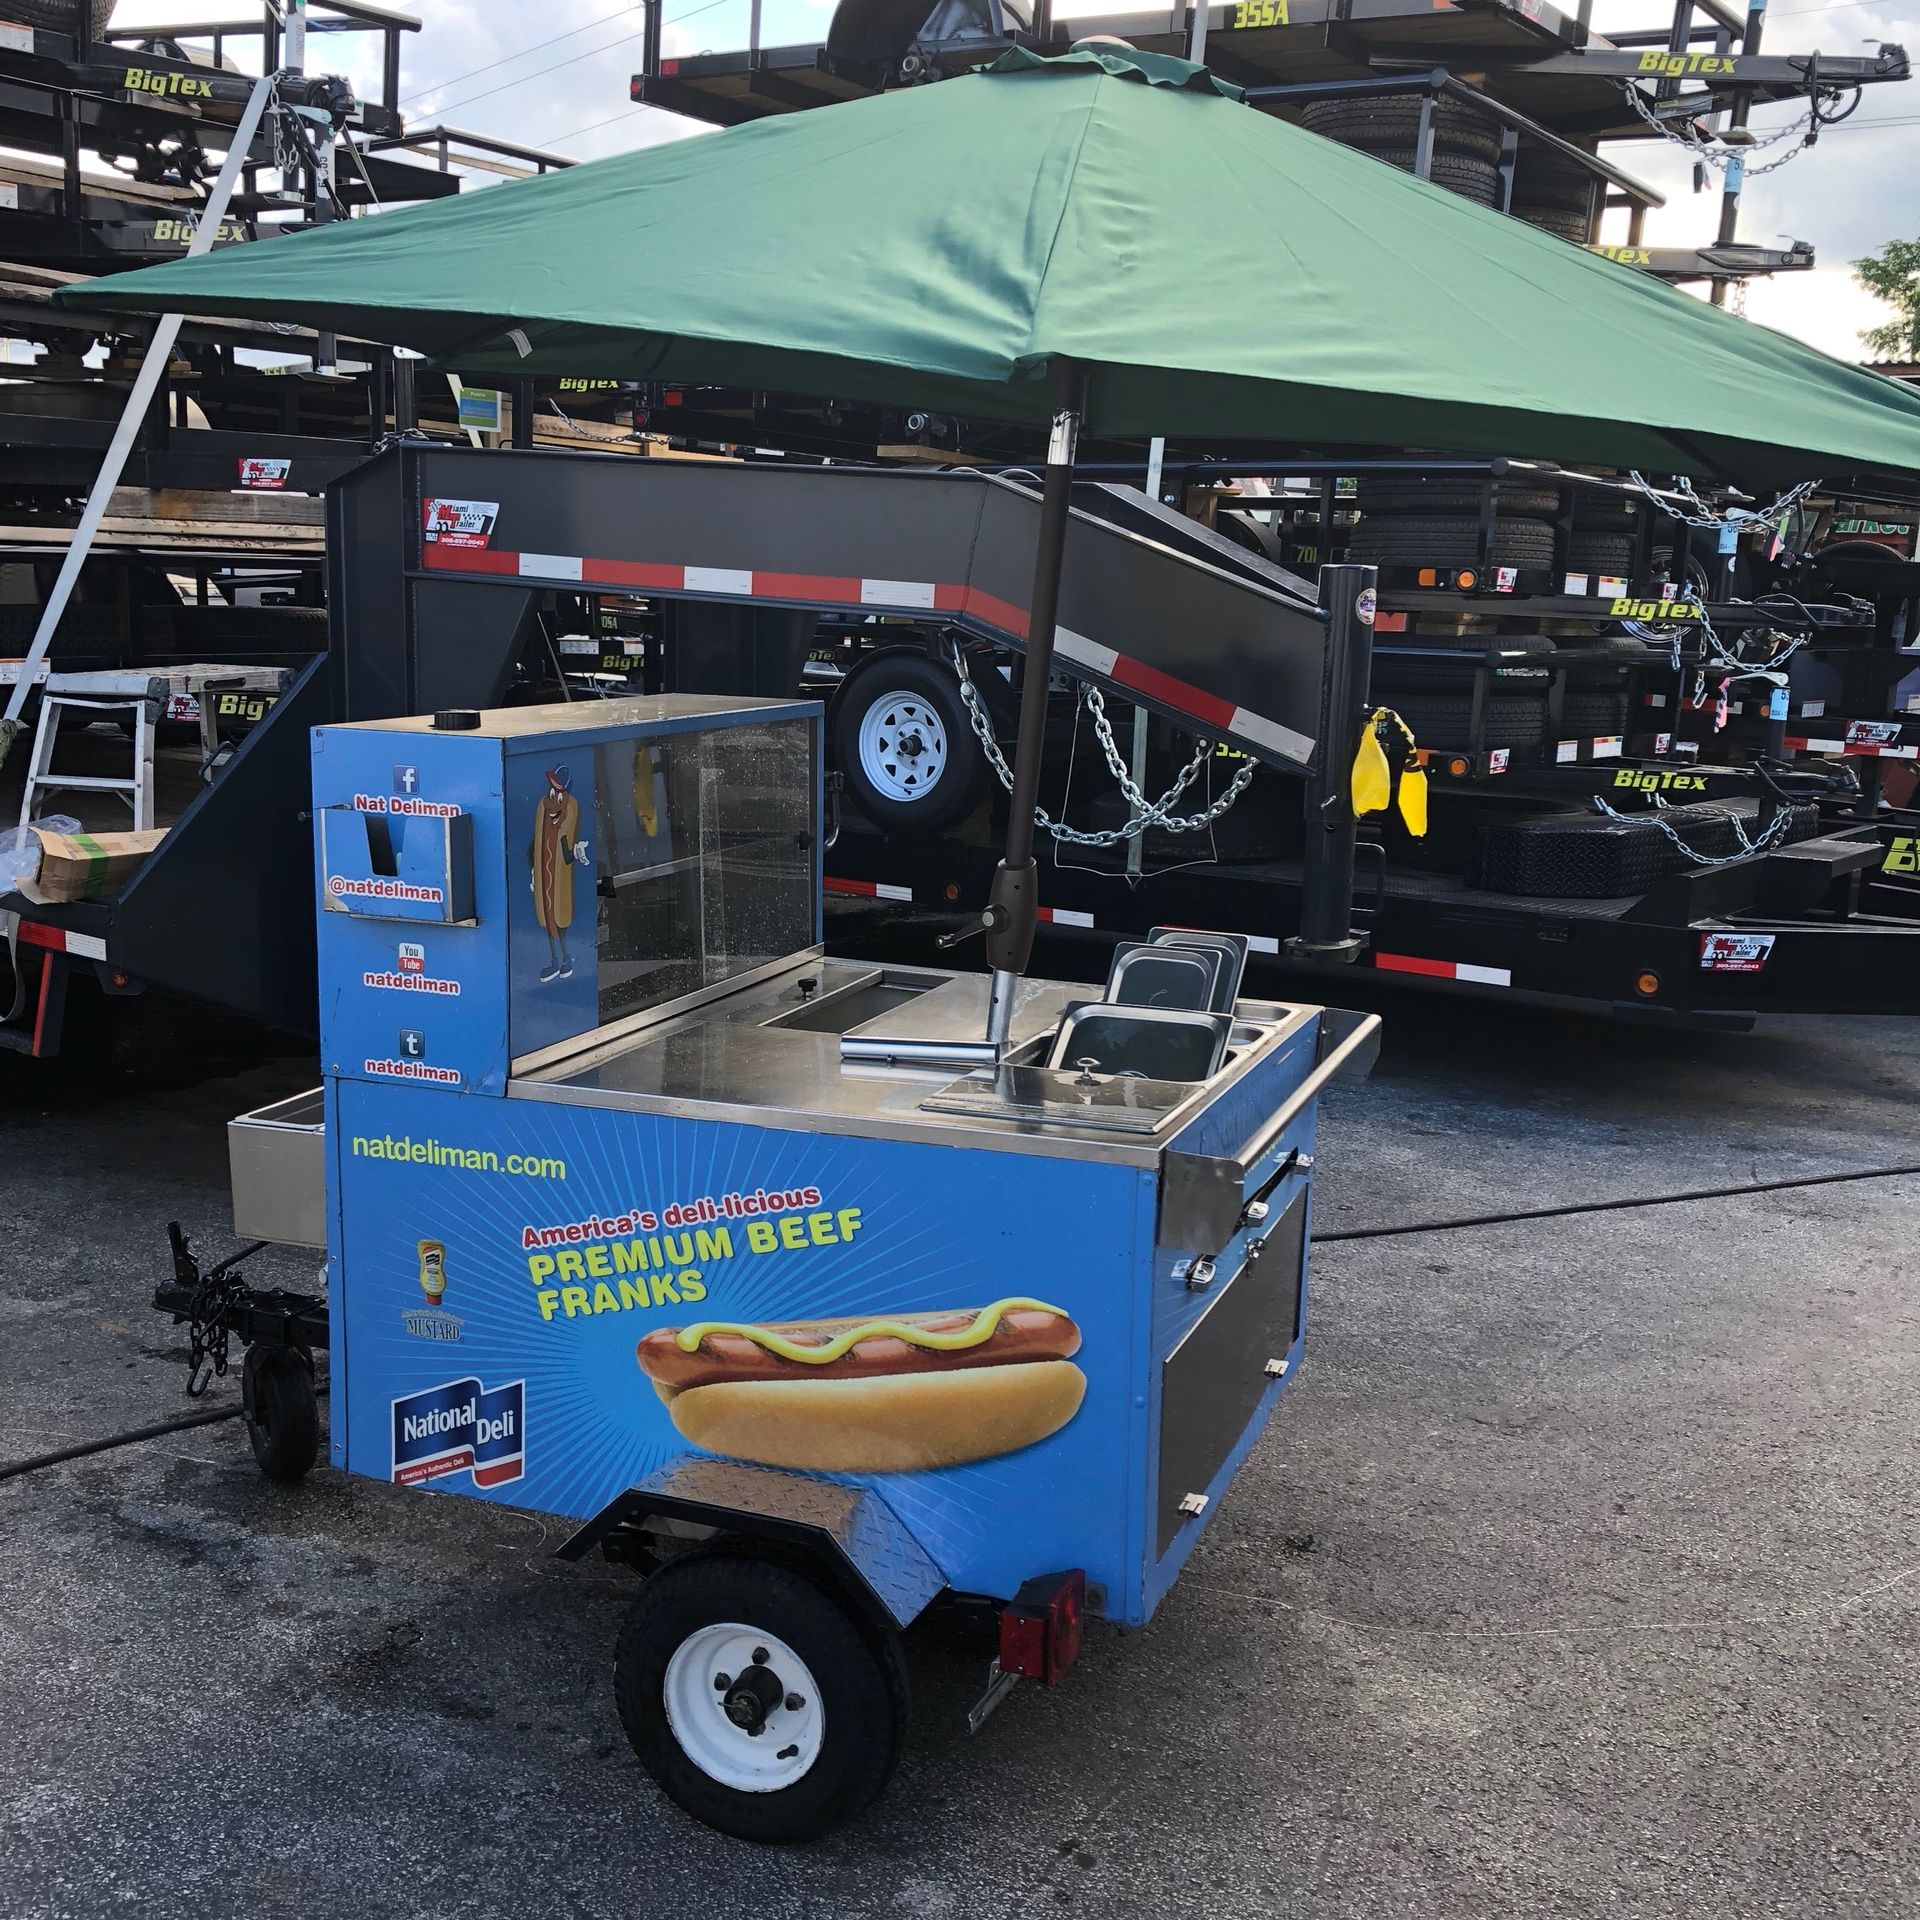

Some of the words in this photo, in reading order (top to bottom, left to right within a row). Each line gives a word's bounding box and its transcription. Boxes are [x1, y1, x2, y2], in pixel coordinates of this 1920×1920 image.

[1638, 51, 1739, 77] BigTex
[124, 67, 213, 98] BigTex
[153, 219, 246, 246] Bigex
[1610, 599, 1705, 621] BigTex
[1614, 770, 1708, 792] BigTex
[355, 795, 386, 812] Nat
[390, 796, 461, 817] Deliman
[1881, 837, 1920, 871] B
[330, 877, 441, 901] @natdeliman
[404, 945, 419, 957] You
[403, 958, 420, 970] Tube
[365, 973, 459, 994] natdeliman
[366, 1060, 460, 1082] natdeliman
[353, 1134, 566, 1180] natdeliman.com
[523, 1213, 657, 1248] America's
[664, 1187, 821, 1227] deli-licious
[528, 1226, 735, 1286] PREMIUM
[747, 1208, 863, 1254] BEEF
[537, 1269, 708, 1321] FRANKS
[408, 1318, 460, 1340] MUSTARD
[404, 1397, 476, 1443] National
[476, 1410, 514, 1445] Deli
